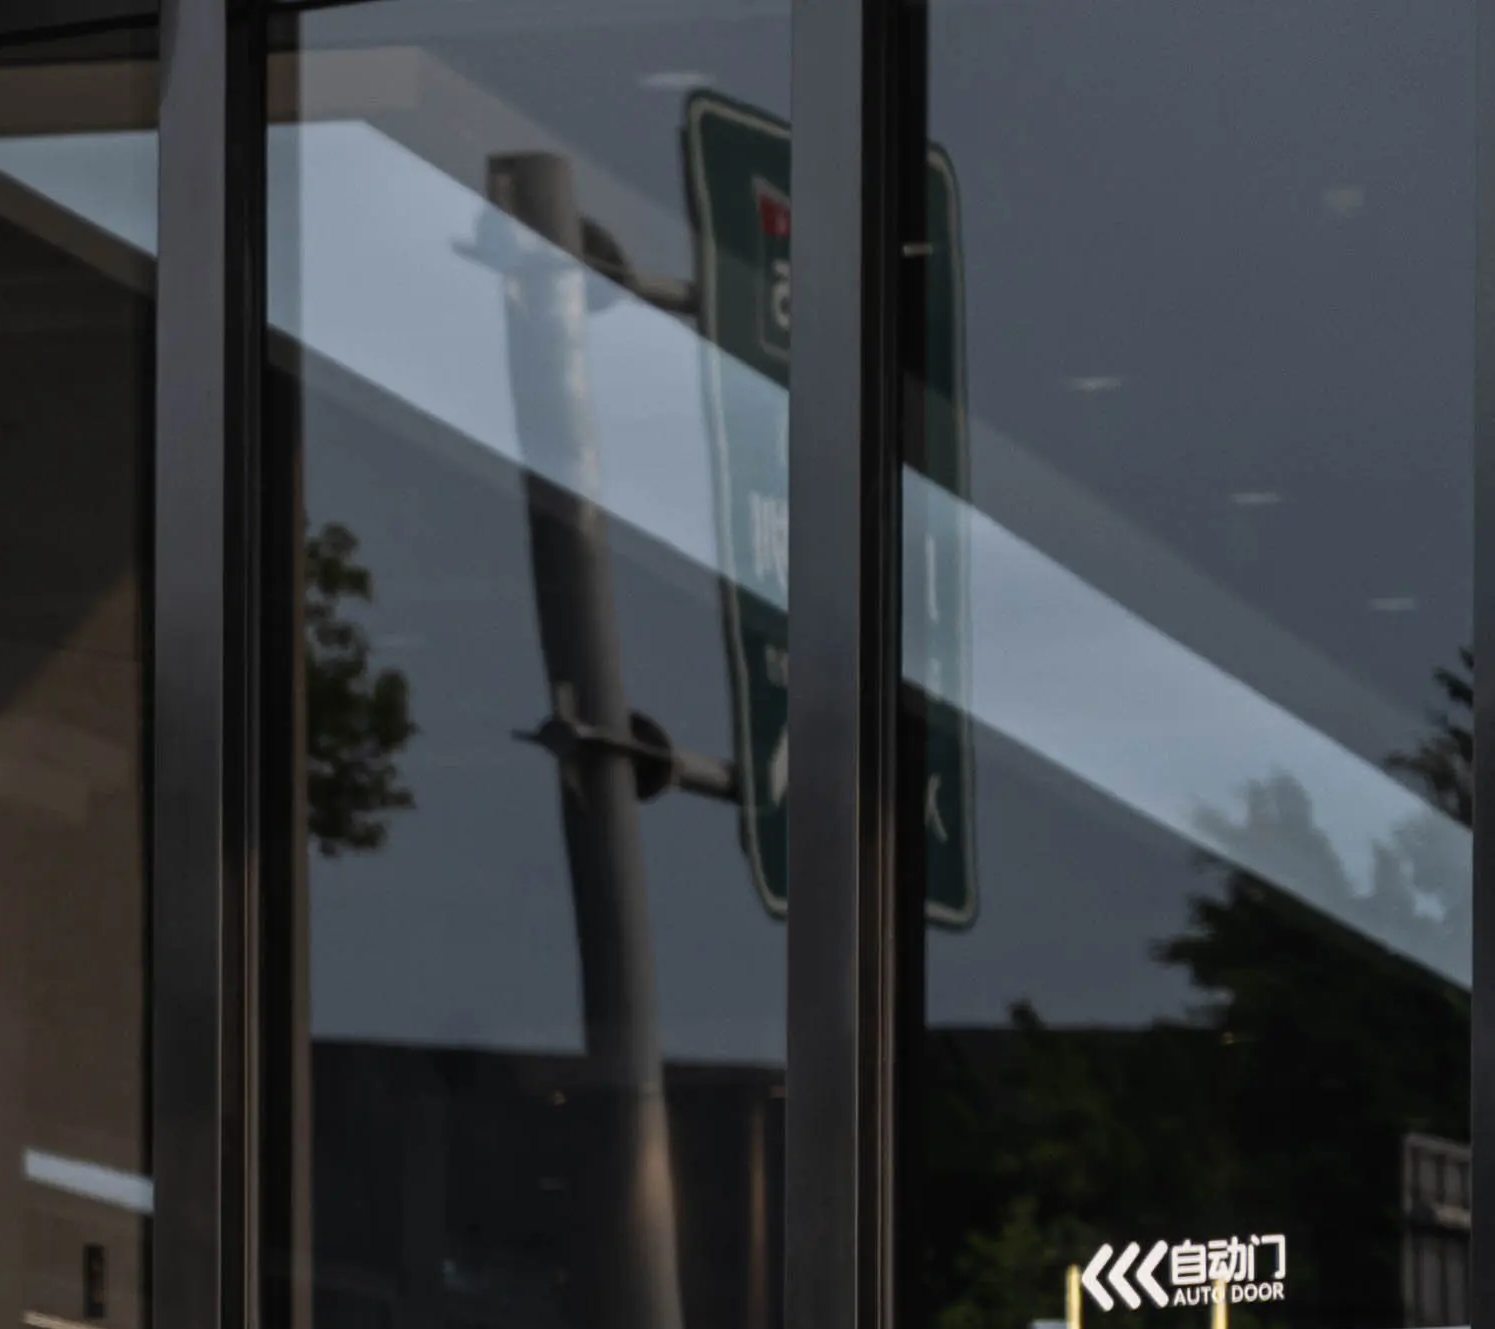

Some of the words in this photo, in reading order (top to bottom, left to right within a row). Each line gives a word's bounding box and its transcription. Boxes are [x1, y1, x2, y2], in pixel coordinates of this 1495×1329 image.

[1171, 1233, 1287, 1285] 自动门
[1173, 1287, 1224, 1307] AUTO
[1231, 1282, 1285, 1302] DOOR
